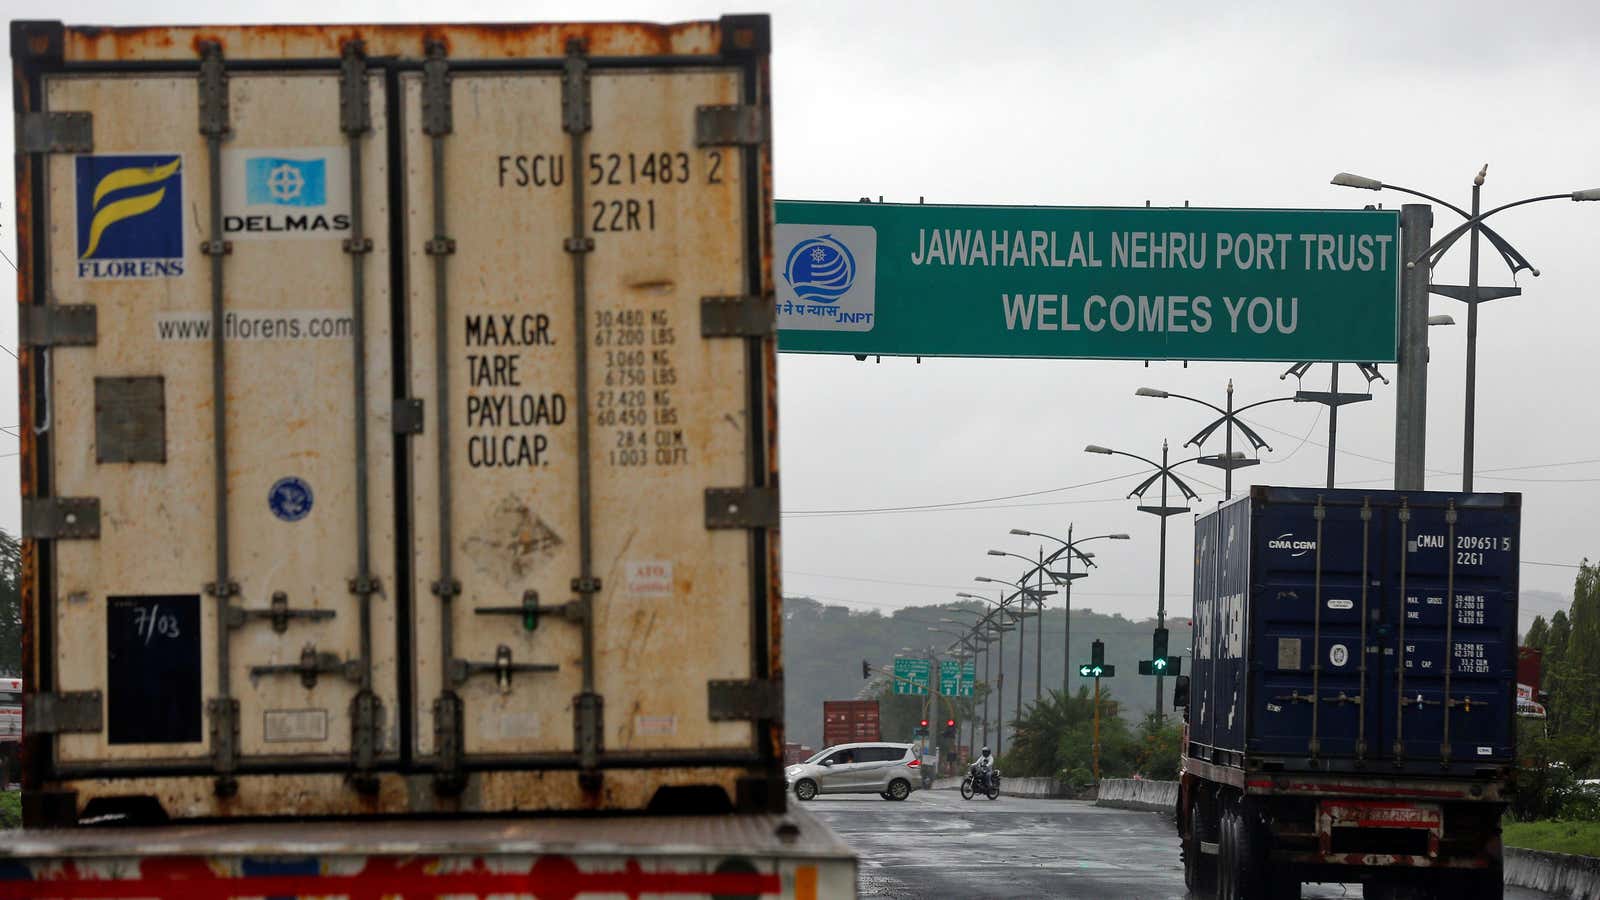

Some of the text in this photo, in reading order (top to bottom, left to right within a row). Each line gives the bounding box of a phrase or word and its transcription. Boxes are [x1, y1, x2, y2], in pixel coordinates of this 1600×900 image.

[498, 152, 723, 187] FSCU 521483 2
[223, 214, 350, 232] DELMAS
[591, 200, 656, 231] 22R1
[911, 228, 1392, 272] JAWAHARLAL NEHRU PORT TRUST
[77, 260, 184, 278] FLORENS
[651, 308, 669, 327] KG
[835, 312, 873, 324] JNPT
[1002, 293, 1299, 334] WELCOMES YOU
[465, 314, 557, 346] MAX.GR.
[651, 327, 676, 346] LBS
[652, 349, 670, 367] KG
[467, 355, 521, 388] TARE
[652, 367, 678, 386] LBS
[653, 388, 670, 406] KG
[467, 393, 567, 427] PAYLOAD
[654, 407, 679, 426] LBS
[467, 434, 549, 469] CU.CAP.
[1268, 540, 1317, 550] CMA CGM
[1417, 535, 1511, 552] CMAU 209651 5
[1457, 552, 1483, 566] 22G1
[1407, 611, 1420, 619] TARE
[1476, 602, 1485, 610] LB
[133, 602, 180, 647] 7/03
[1476, 617, 1484, 625] LB
[1406, 645, 1416, 653] NET
[1476, 650, 1484, 658] LB
